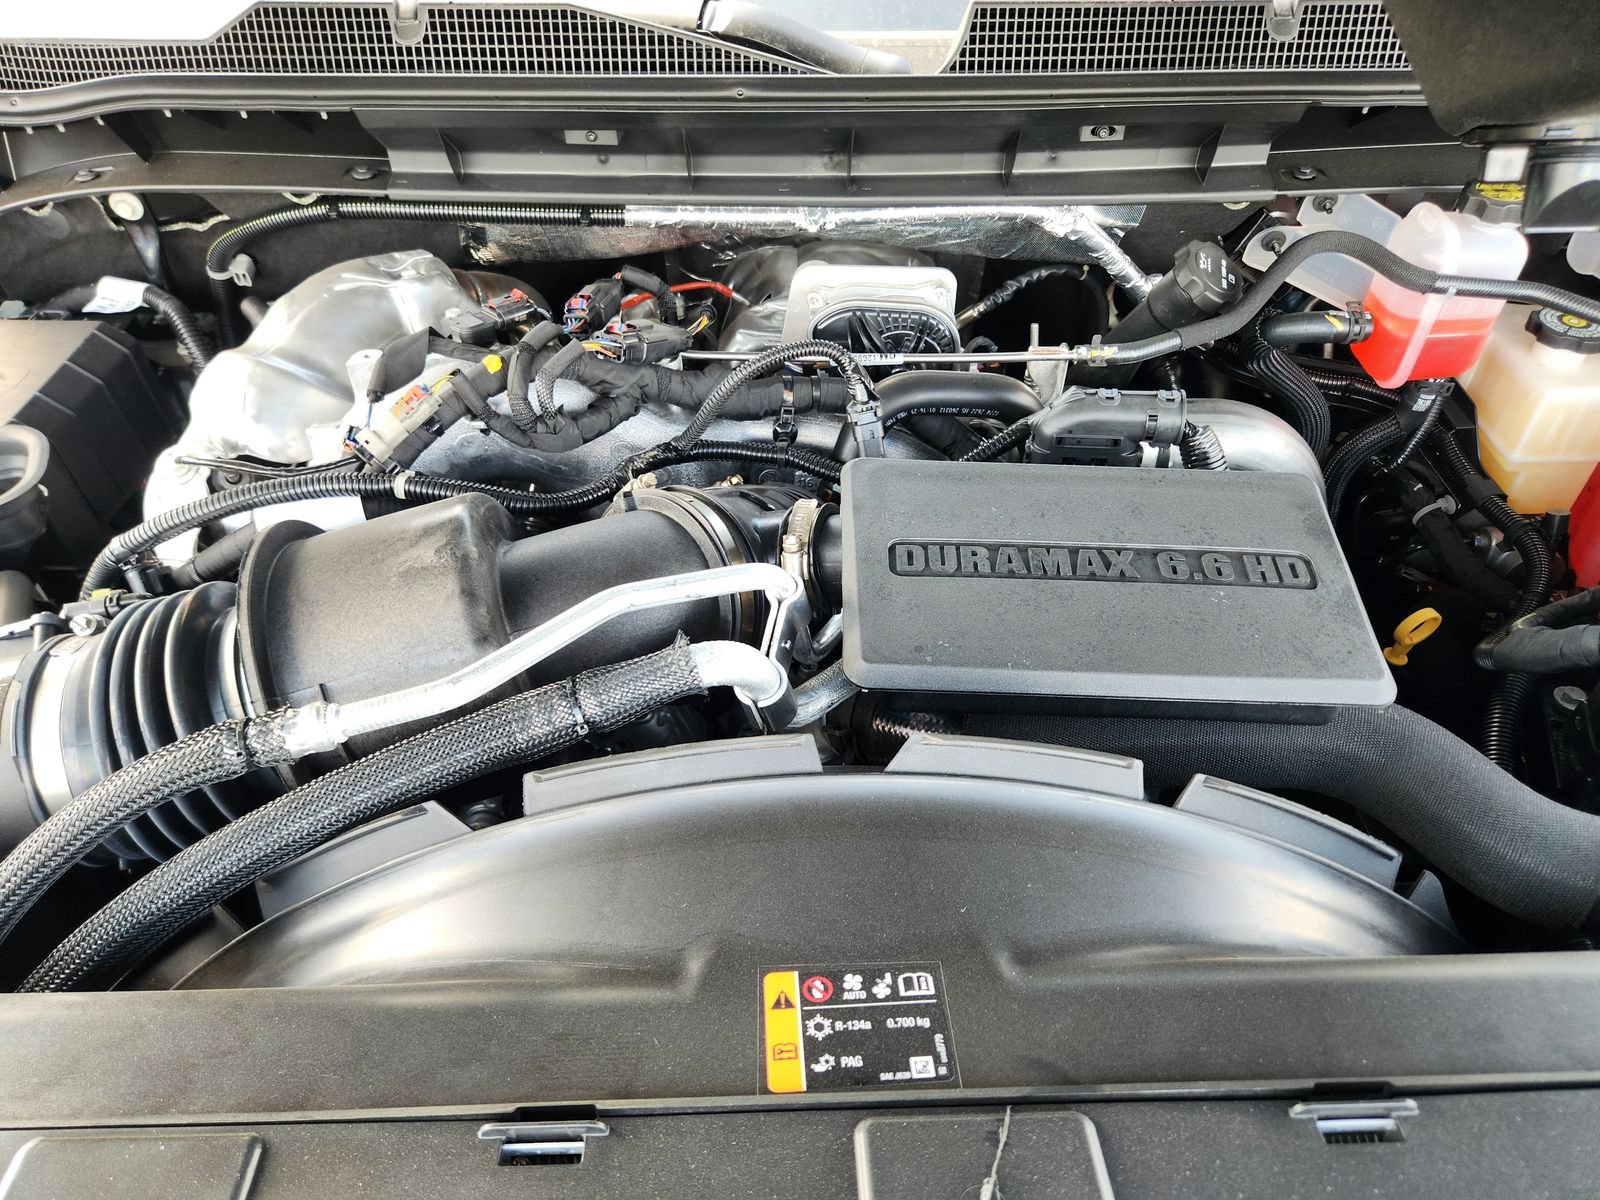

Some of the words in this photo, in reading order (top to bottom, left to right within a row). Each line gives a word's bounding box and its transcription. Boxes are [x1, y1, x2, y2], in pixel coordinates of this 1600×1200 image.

[895, 544, 1141, 579] DURAMAX
[1156, 551, 1235, 581] 6.6
[1242, 554, 1312, 586] HD
[843, 990, 867, 1000] AUTO
[835, 1019, 872, 1031] R-134a
[886, 1016, 916, 1029] 0.700
[916, 1016, 931, 1029] kg
[840, 1055, 864, 1068] PAG
